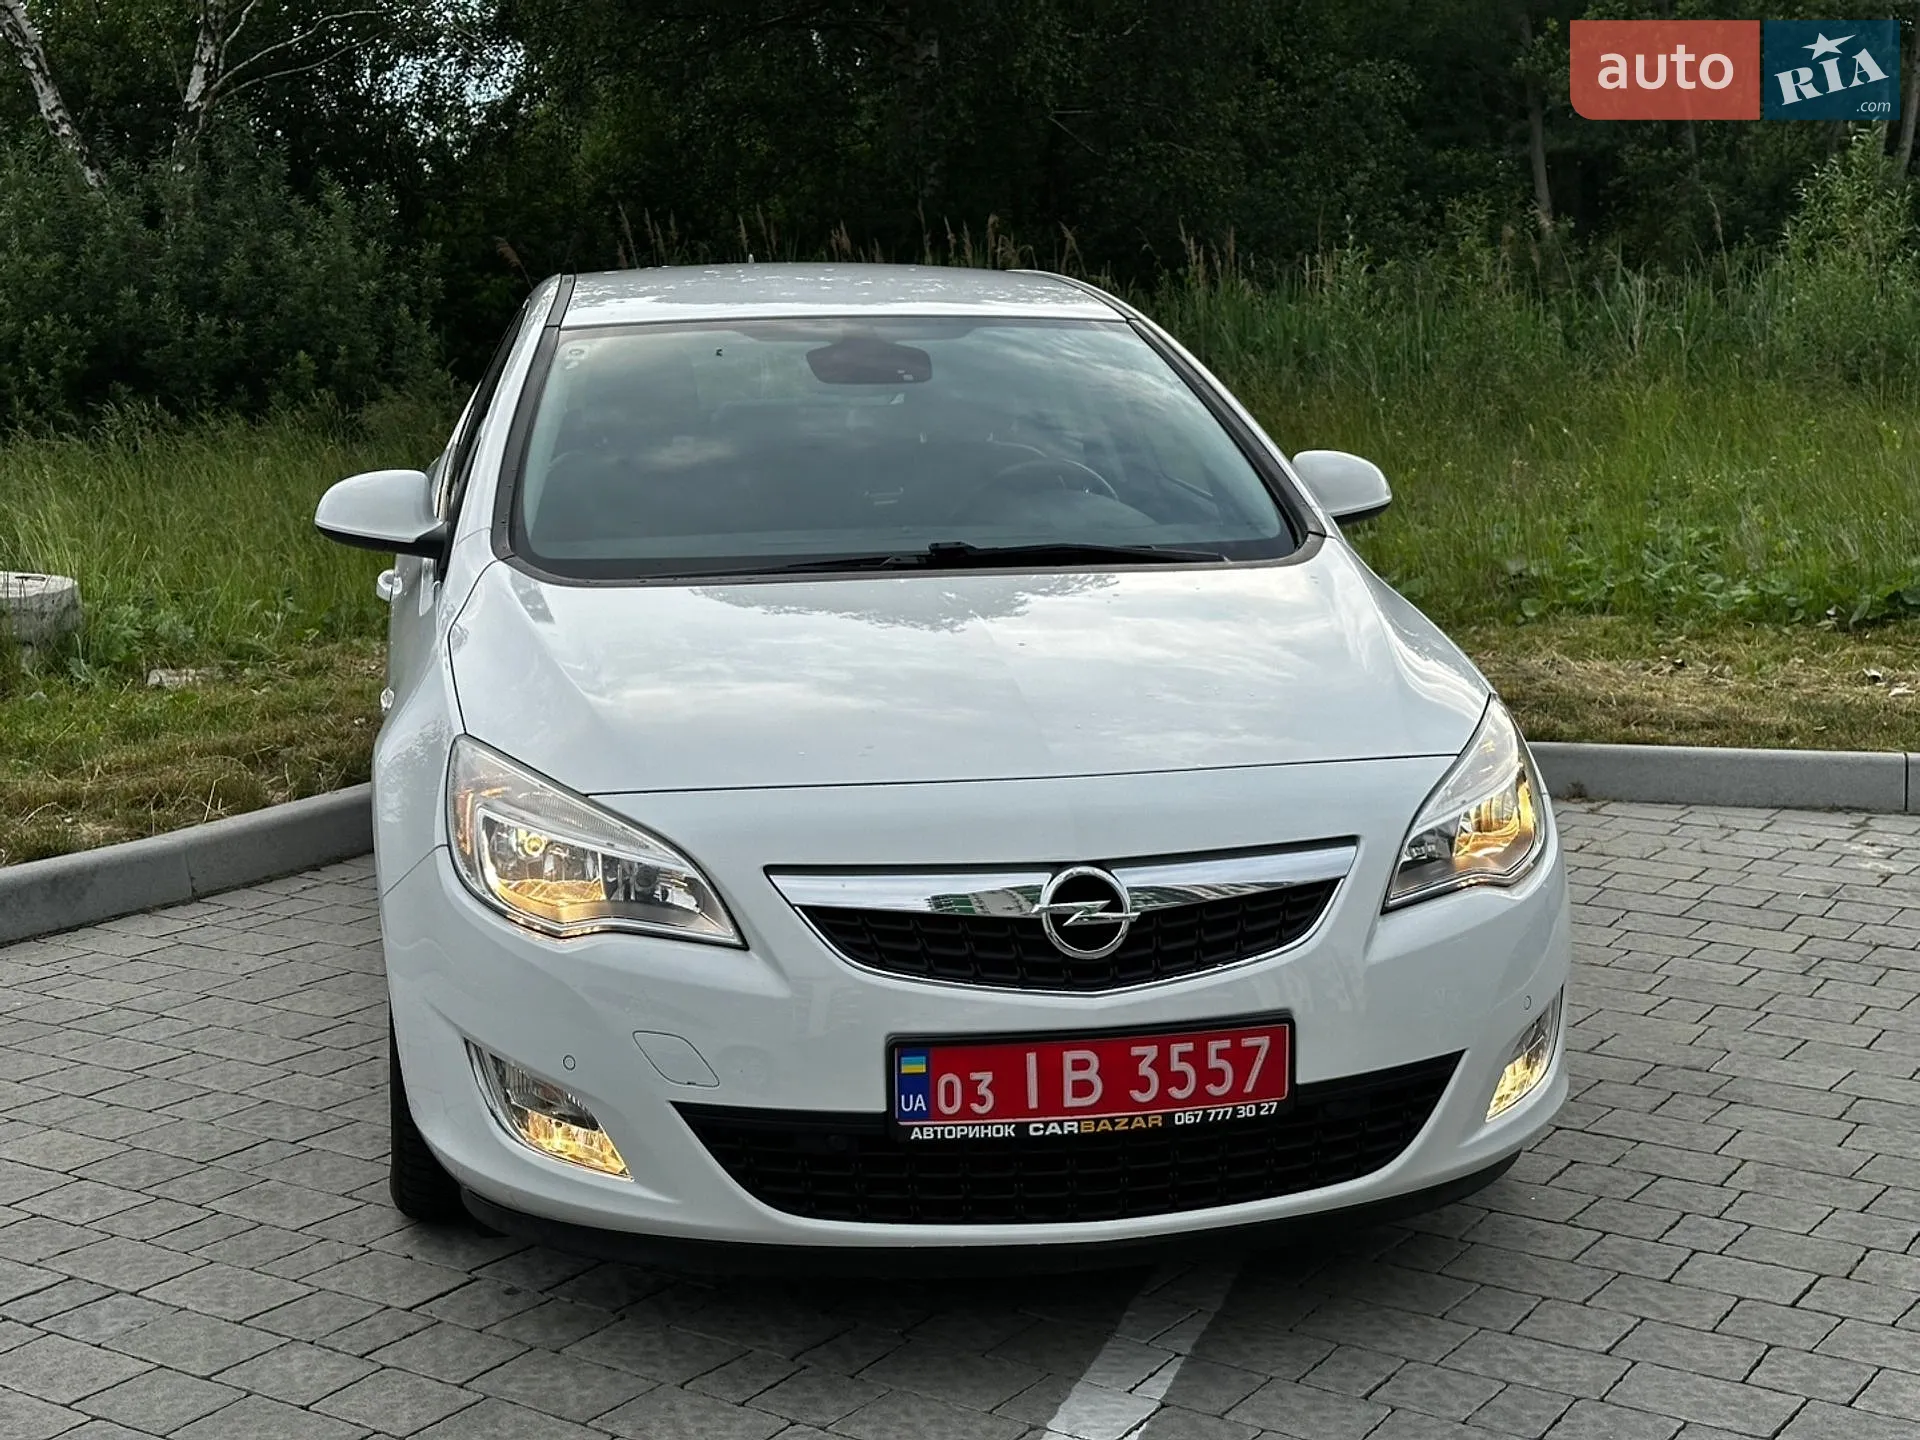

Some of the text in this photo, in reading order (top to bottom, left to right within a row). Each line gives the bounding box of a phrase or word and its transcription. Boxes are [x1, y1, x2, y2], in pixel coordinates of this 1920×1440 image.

[937, 1036, 1271, 1115] 03 IB 3557
[901, 1094, 926, 1112] UA
[910, 1101, 1278, 1140] АВТОРИНОК CARBAZAR 067 777 30 27
